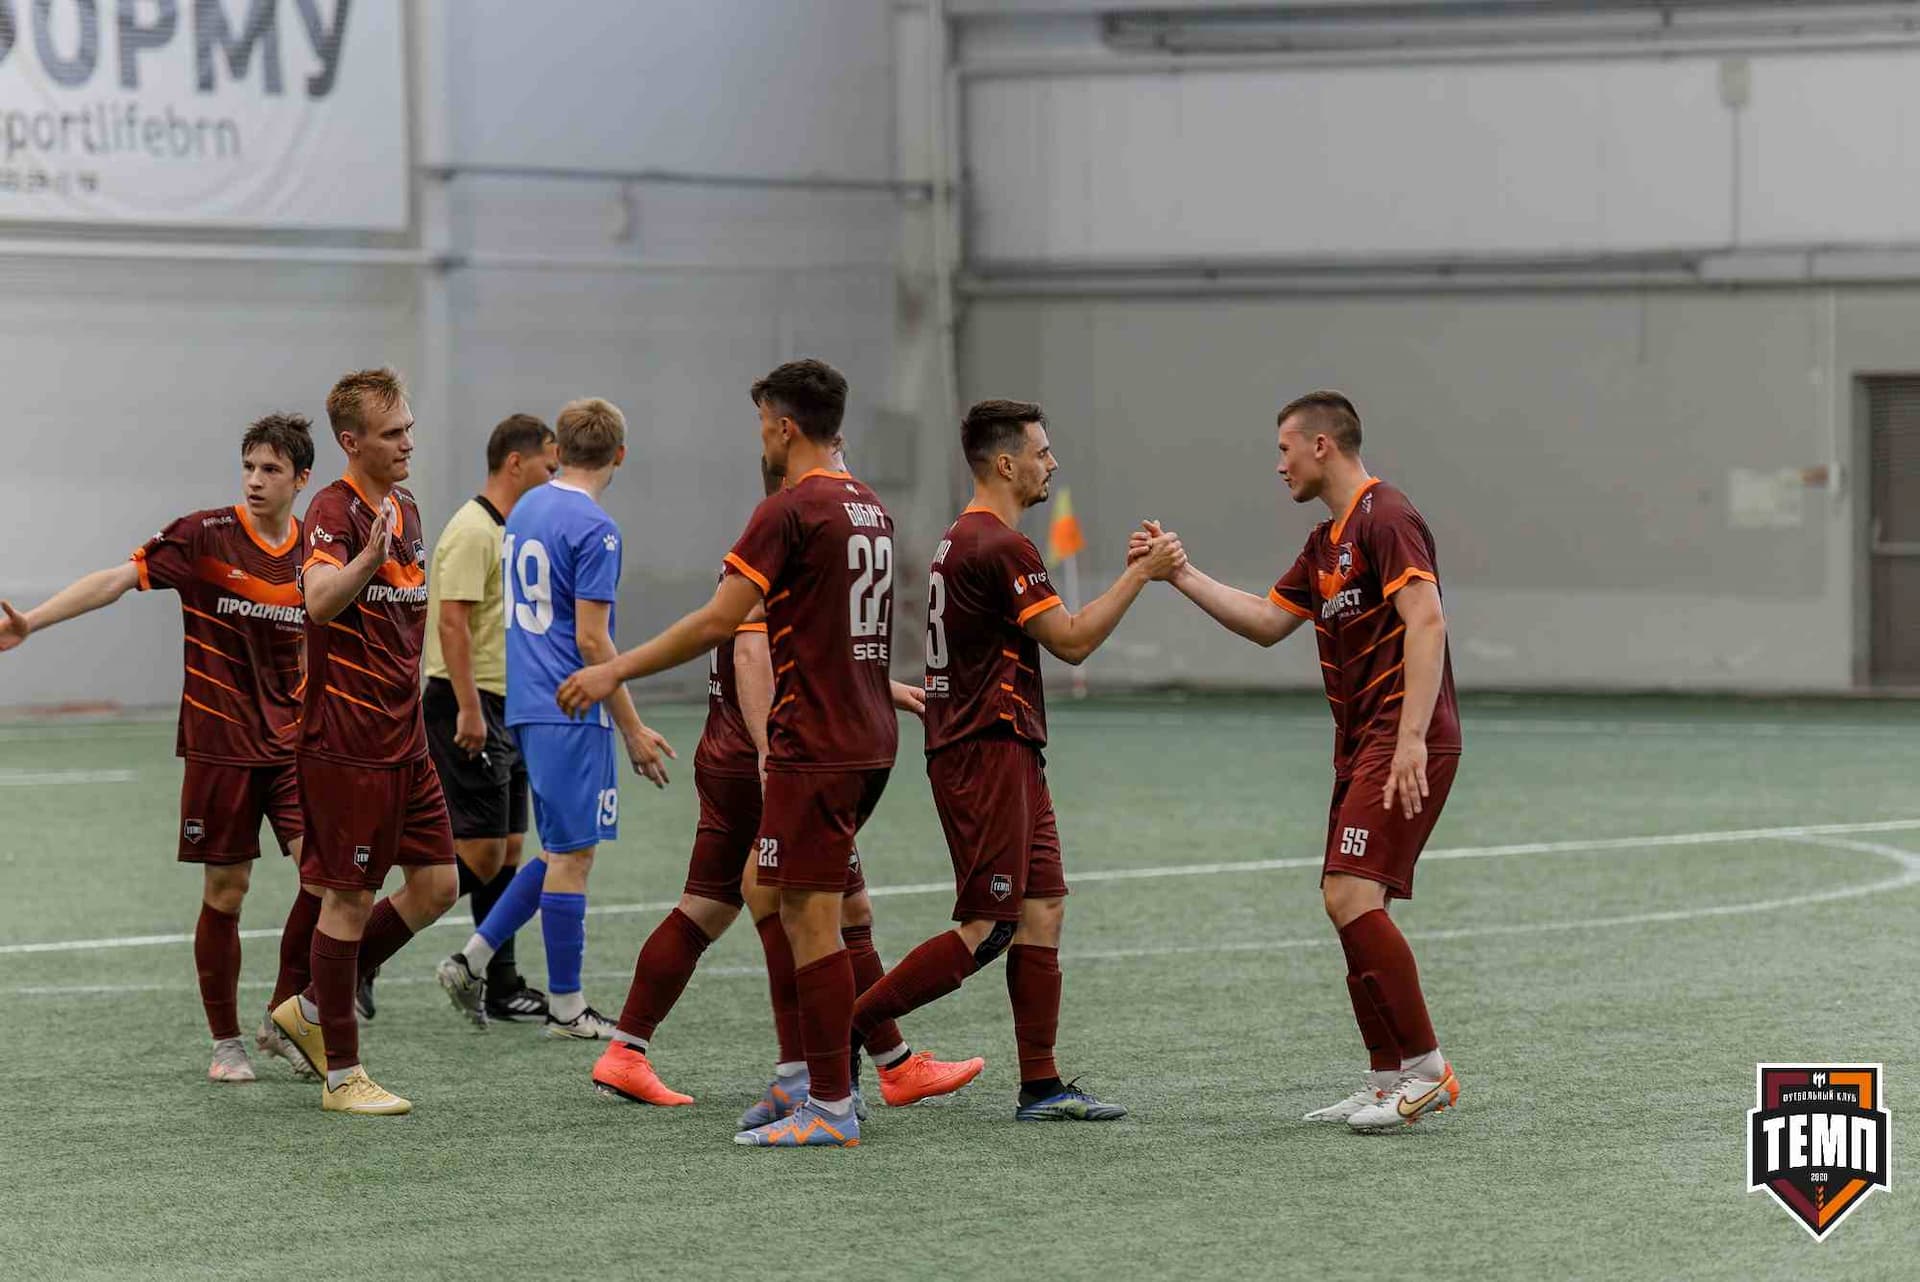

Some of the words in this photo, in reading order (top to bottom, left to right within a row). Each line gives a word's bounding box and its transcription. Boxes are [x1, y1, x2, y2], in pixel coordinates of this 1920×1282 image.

[0, 0, 350, 97] ОРМУ
[0, 102, 241, 159] portlifebrn
[501, 534, 553, 635] 19
[848, 534, 893, 638] 22
[853, 643, 888, 660] SEE
[597, 788, 618, 828] 19
[758, 838, 778, 868] 22
[1340, 826, 1369, 857] 55
